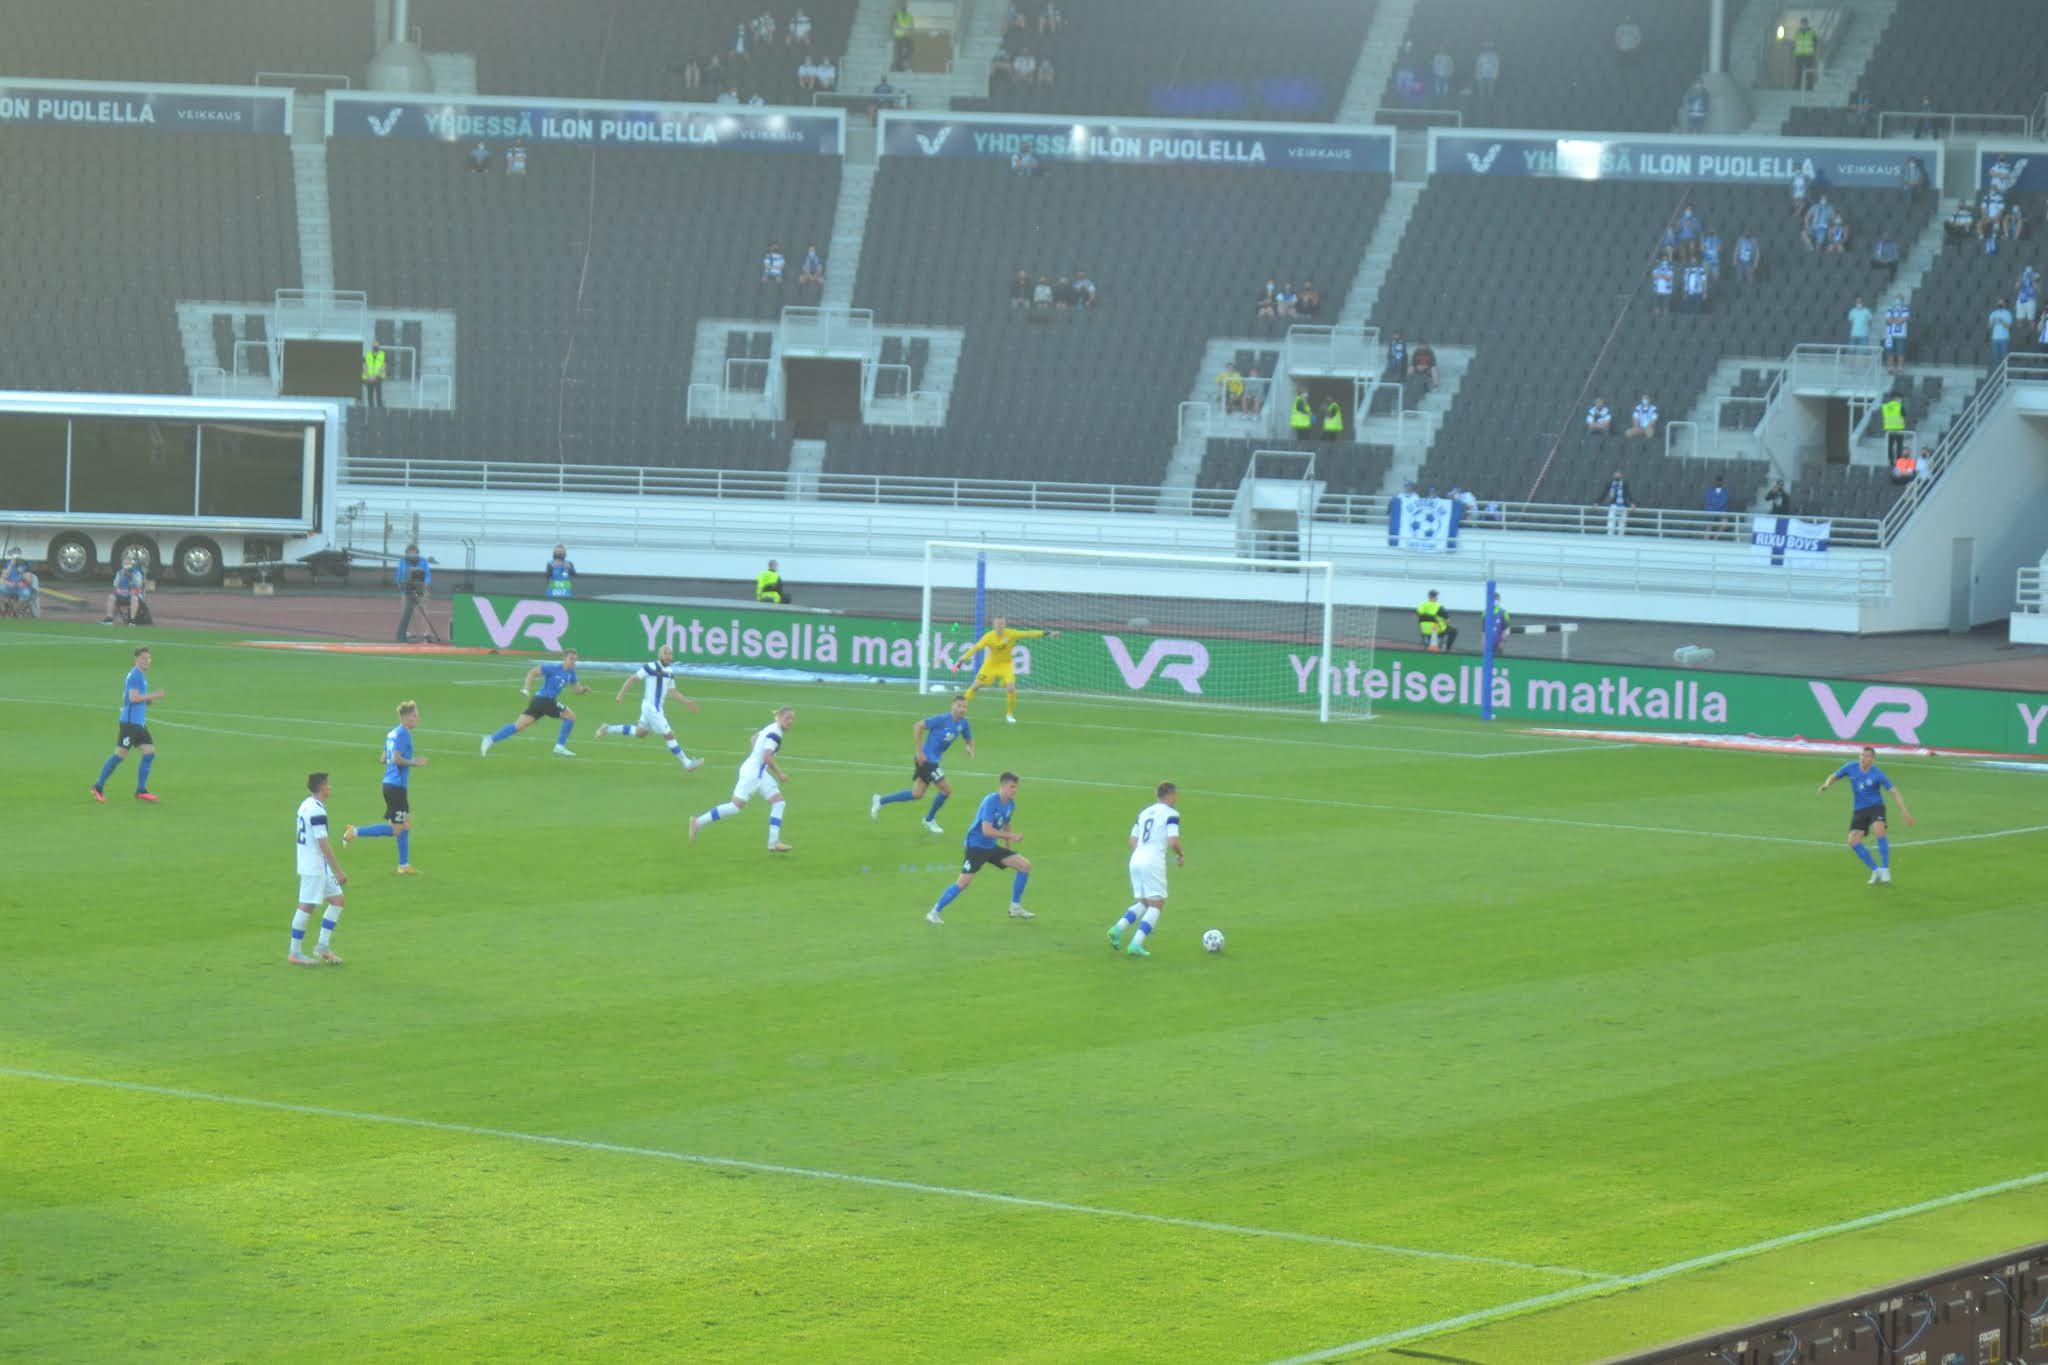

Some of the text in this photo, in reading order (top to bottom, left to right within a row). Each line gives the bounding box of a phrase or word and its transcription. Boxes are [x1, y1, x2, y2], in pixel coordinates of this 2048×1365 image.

[37, 99, 155, 123] PUOLELLA
[177, 109, 241, 121] VEIKKAUS
[424, 111, 718, 144] YHDESSÄ ILON PUOLELLA
[1091, 135, 1141, 158] ILON
[1149, 138, 1266, 162] PUOLELLA
[1288, 147, 1351, 160] VEIKKAUS
[1523, 147, 1632, 173] YHSÄ
[1640, 152, 1691, 175] ILON
[1838, 163, 1901, 176] VEIKKAUS
[1756, 532, 1819, 551] RIXU BOYS
[472, 596, 569, 652] VR
[639, 613, 1031, 676] Yhteisellä makaa
[1102, 634, 1210, 695] VR
[1288, 654, 1728, 723] Yhteisellä matkalla
[1808, 681, 1928, 744] VR
[1142, 817, 1155, 844] 8
